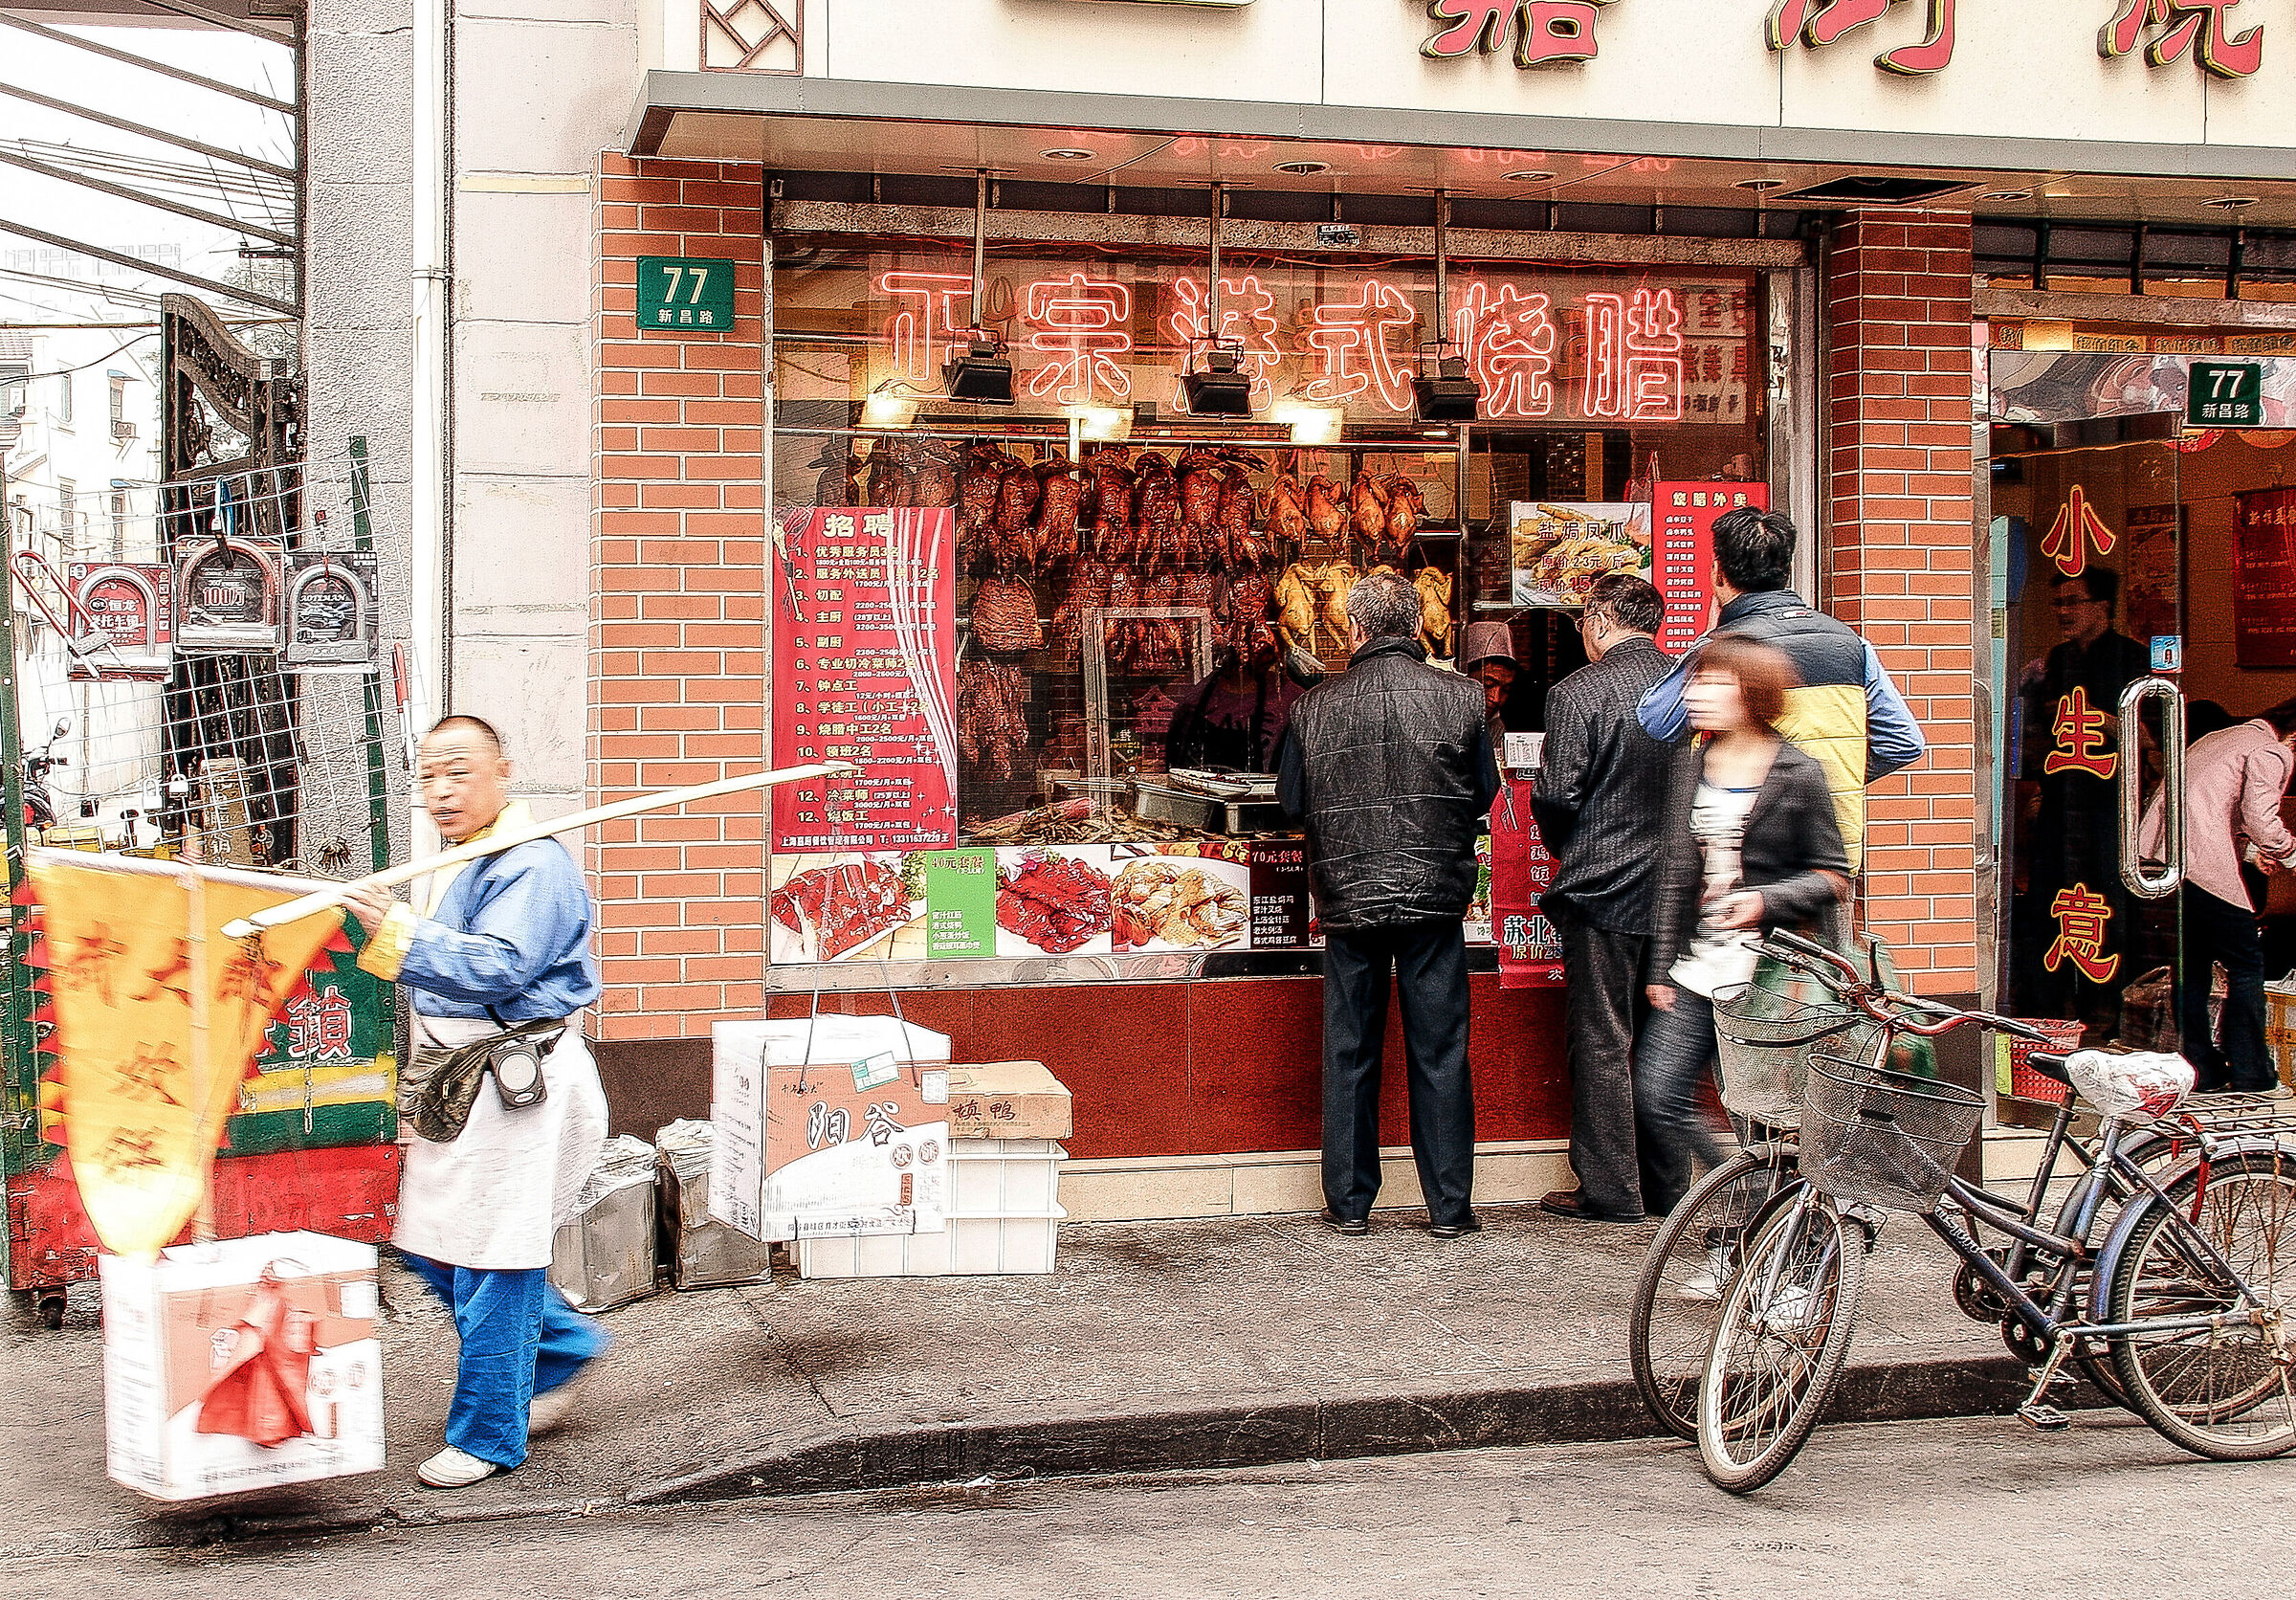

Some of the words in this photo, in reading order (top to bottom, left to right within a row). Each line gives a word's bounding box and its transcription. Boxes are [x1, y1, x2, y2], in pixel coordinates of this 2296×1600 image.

[662, 266, 710, 305] 77
[657, 307, 715, 325] 新昌路
[2209, 369, 2245, 399] 77
[2201, 403, 2249, 419] 新昌路
[1671, 491, 1748, 507] 烧腊外卖
[822, 513, 895, 538] 招聘
[1537, 522, 1625, 541] 盐焗凤爪
